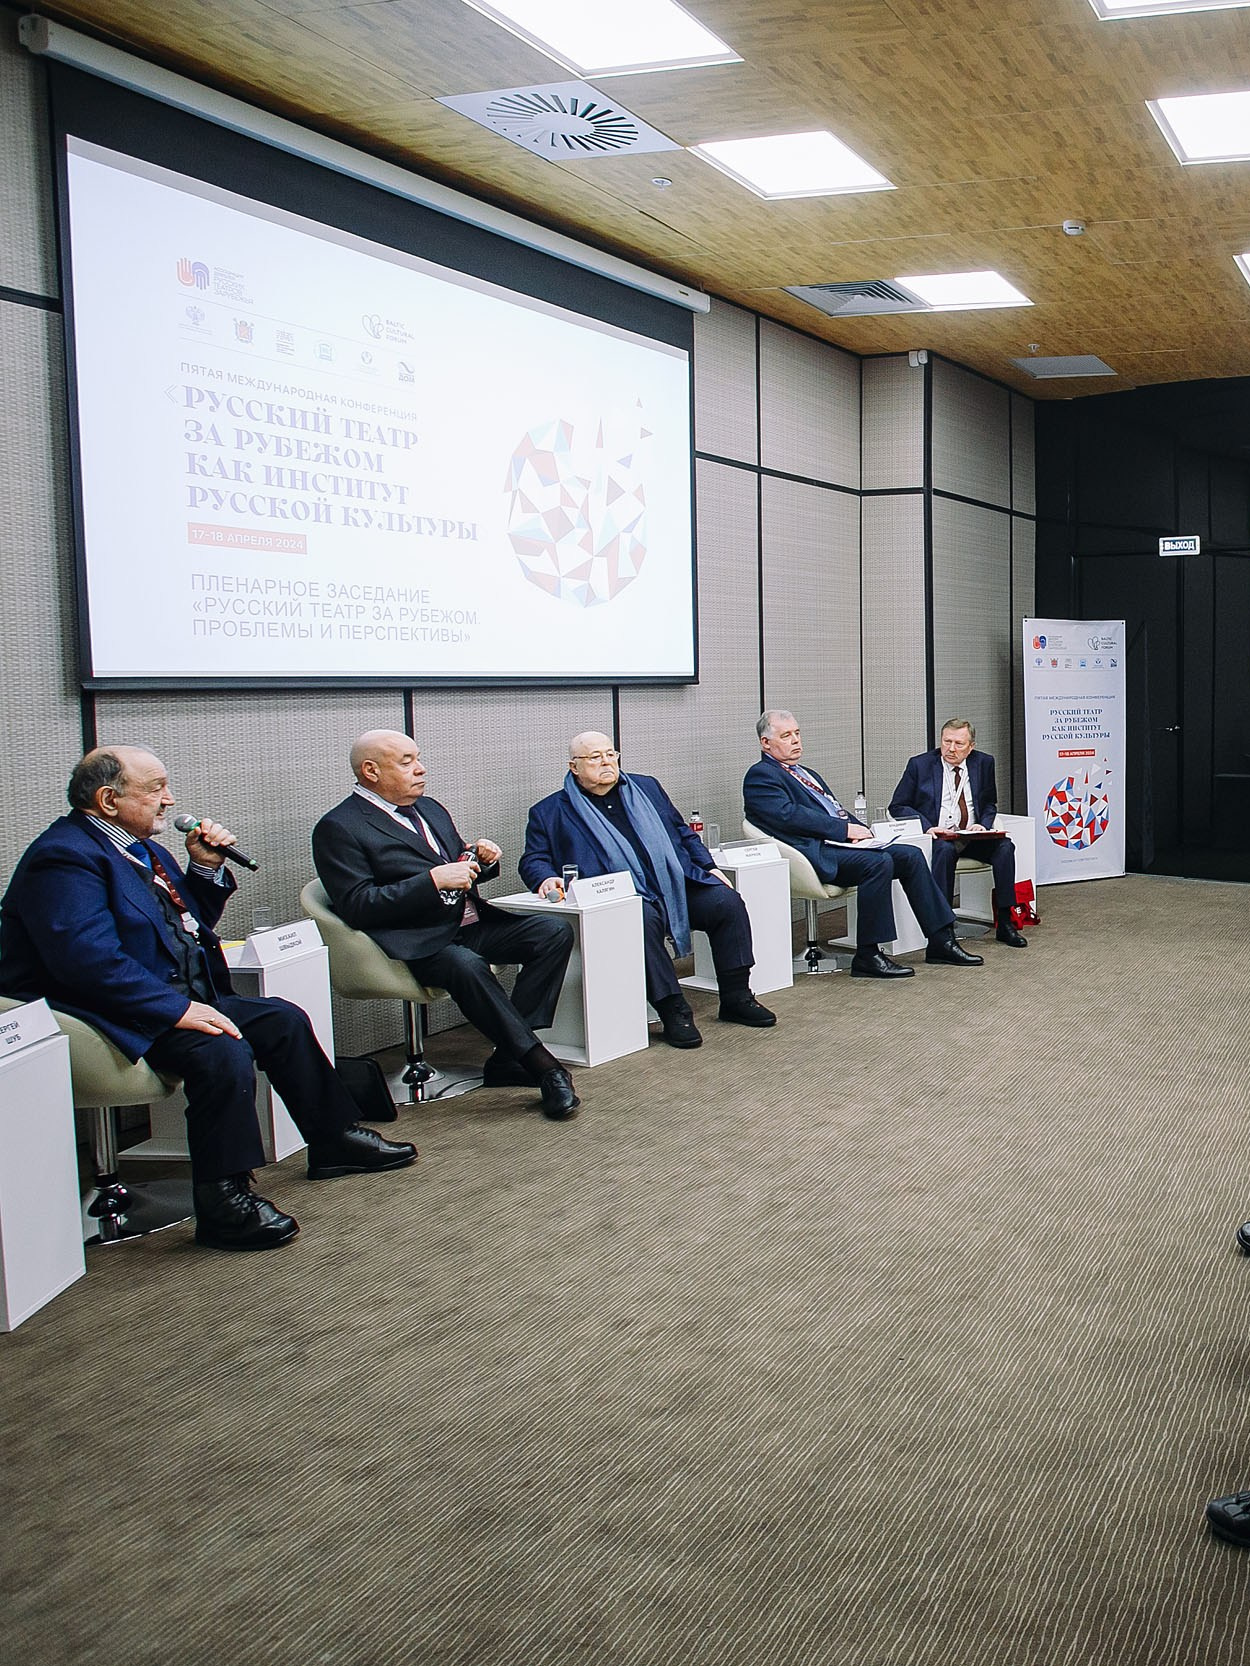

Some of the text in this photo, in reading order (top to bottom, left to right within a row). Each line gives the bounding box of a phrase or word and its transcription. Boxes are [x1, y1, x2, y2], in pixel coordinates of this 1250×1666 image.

[180, 362, 223, 381] ПЯТАЯ
[227, 372, 338, 404] МЕЖДУНАРОДНАЯ
[340, 399, 417, 421] КОНФЕРЕНЦИЯ
[181, 384, 419, 450] РУССКИЙ ТЕАТР
[184, 419, 385, 474] ЗА РУБЕЖОМ
[185, 451, 410, 505] КАК ИНСТИТУТ
[186, 485, 479, 541] РУССКОЙ КУЛЬТУРЫ
[191, 528, 304, 550] 17-18 АПРЕЛЯ 2024
[1164, 540, 1195, 551] ВЫХОД
[191, 573, 431, 604] ПЛЕНАРНОЕ ЗАСЕДАНИЕ
[192, 596, 302, 618] «РУССКИЙ
[309, 602, 366, 621] ТЕАТР
[371, 605, 393, 622] ЗА
[192, 619, 471, 643] ПРОБЛЕМЫ И ПЕРСПЕКТИВЫ»
[1049, 707, 1103, 716] РУССКИЙ ТЕАТР
[1064, 716, 1098, 724] РУБЕЖОМ
[1042, 732, 1073, 740] РУССКОЙ
[0, 1020, 19, 1035] ЕРГЕЙ
[5, 1033, 22, 1045] ШУБ
